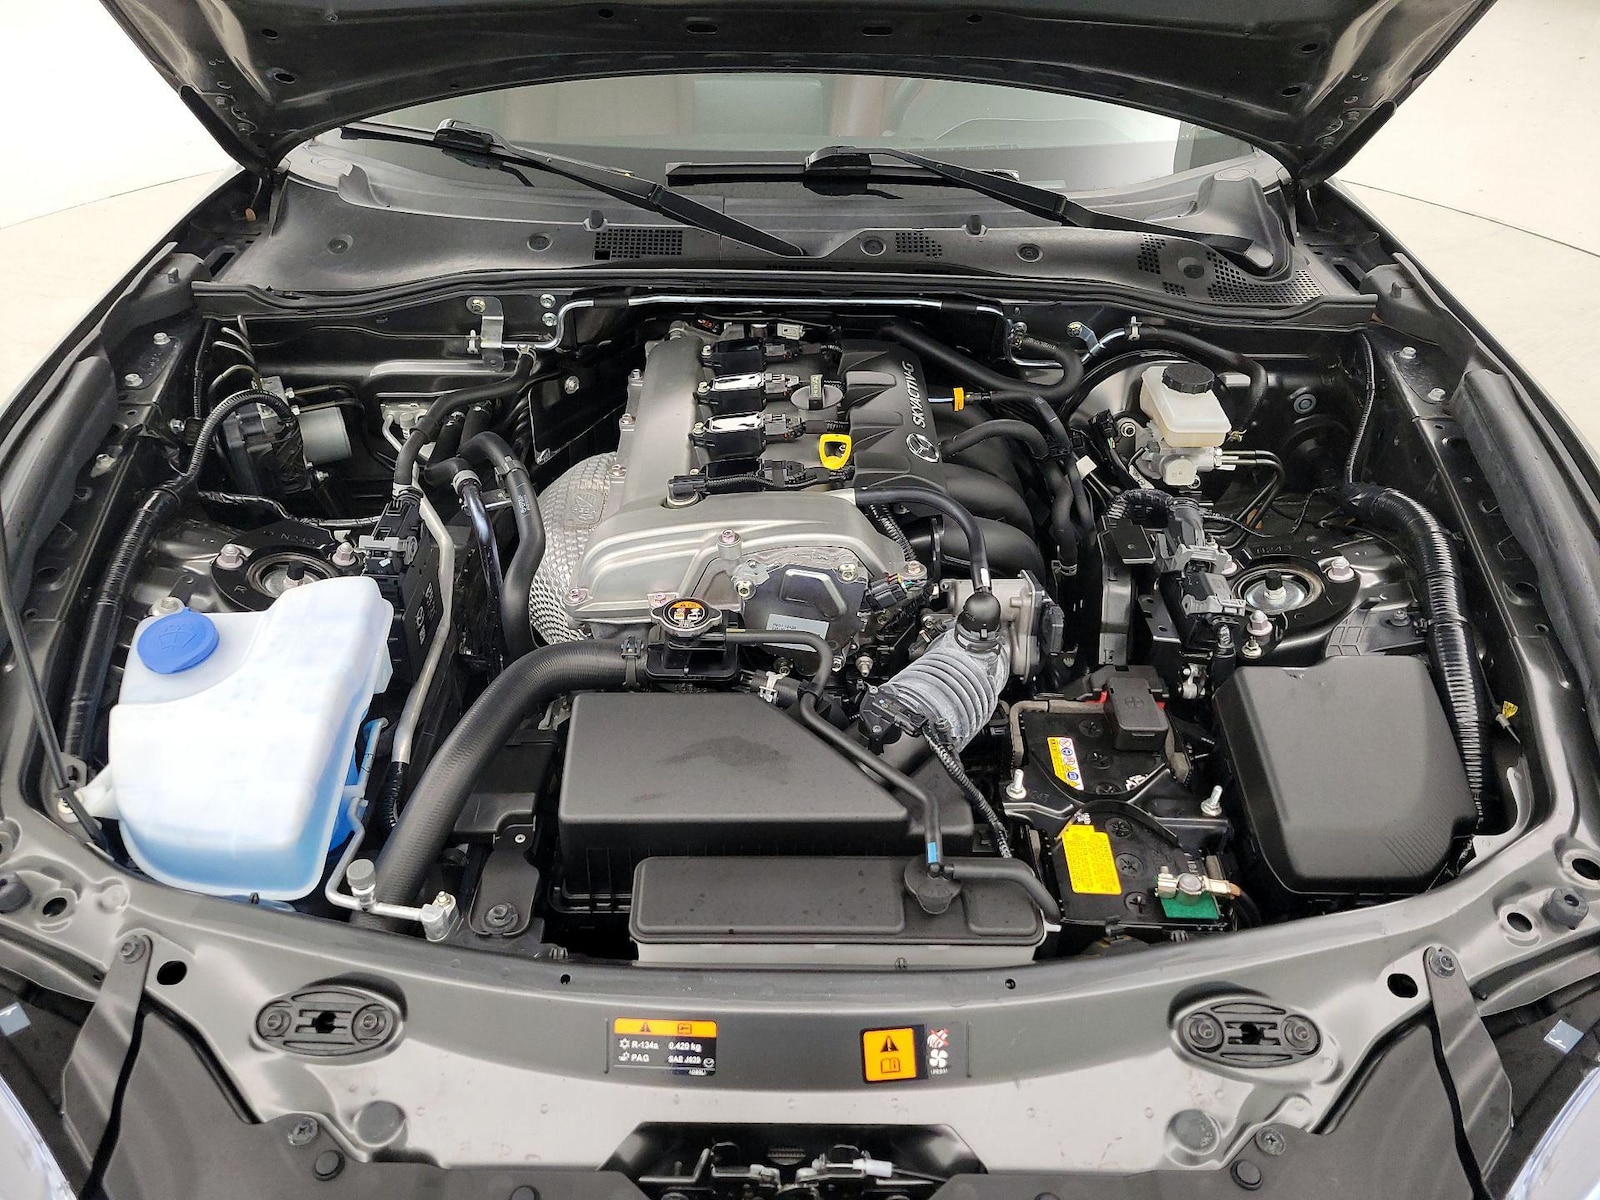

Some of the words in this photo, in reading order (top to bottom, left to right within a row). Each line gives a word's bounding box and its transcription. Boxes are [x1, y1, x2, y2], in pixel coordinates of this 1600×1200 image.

[902, 360, 926, 429] SKYACTIV-G
[631, 1040, 659, 1050] R-134a
[668, 1041, 690, 1051] 0.420
[690, 1042, 702, 1053] kg
[630, 1053, 650, 1063] PAG
